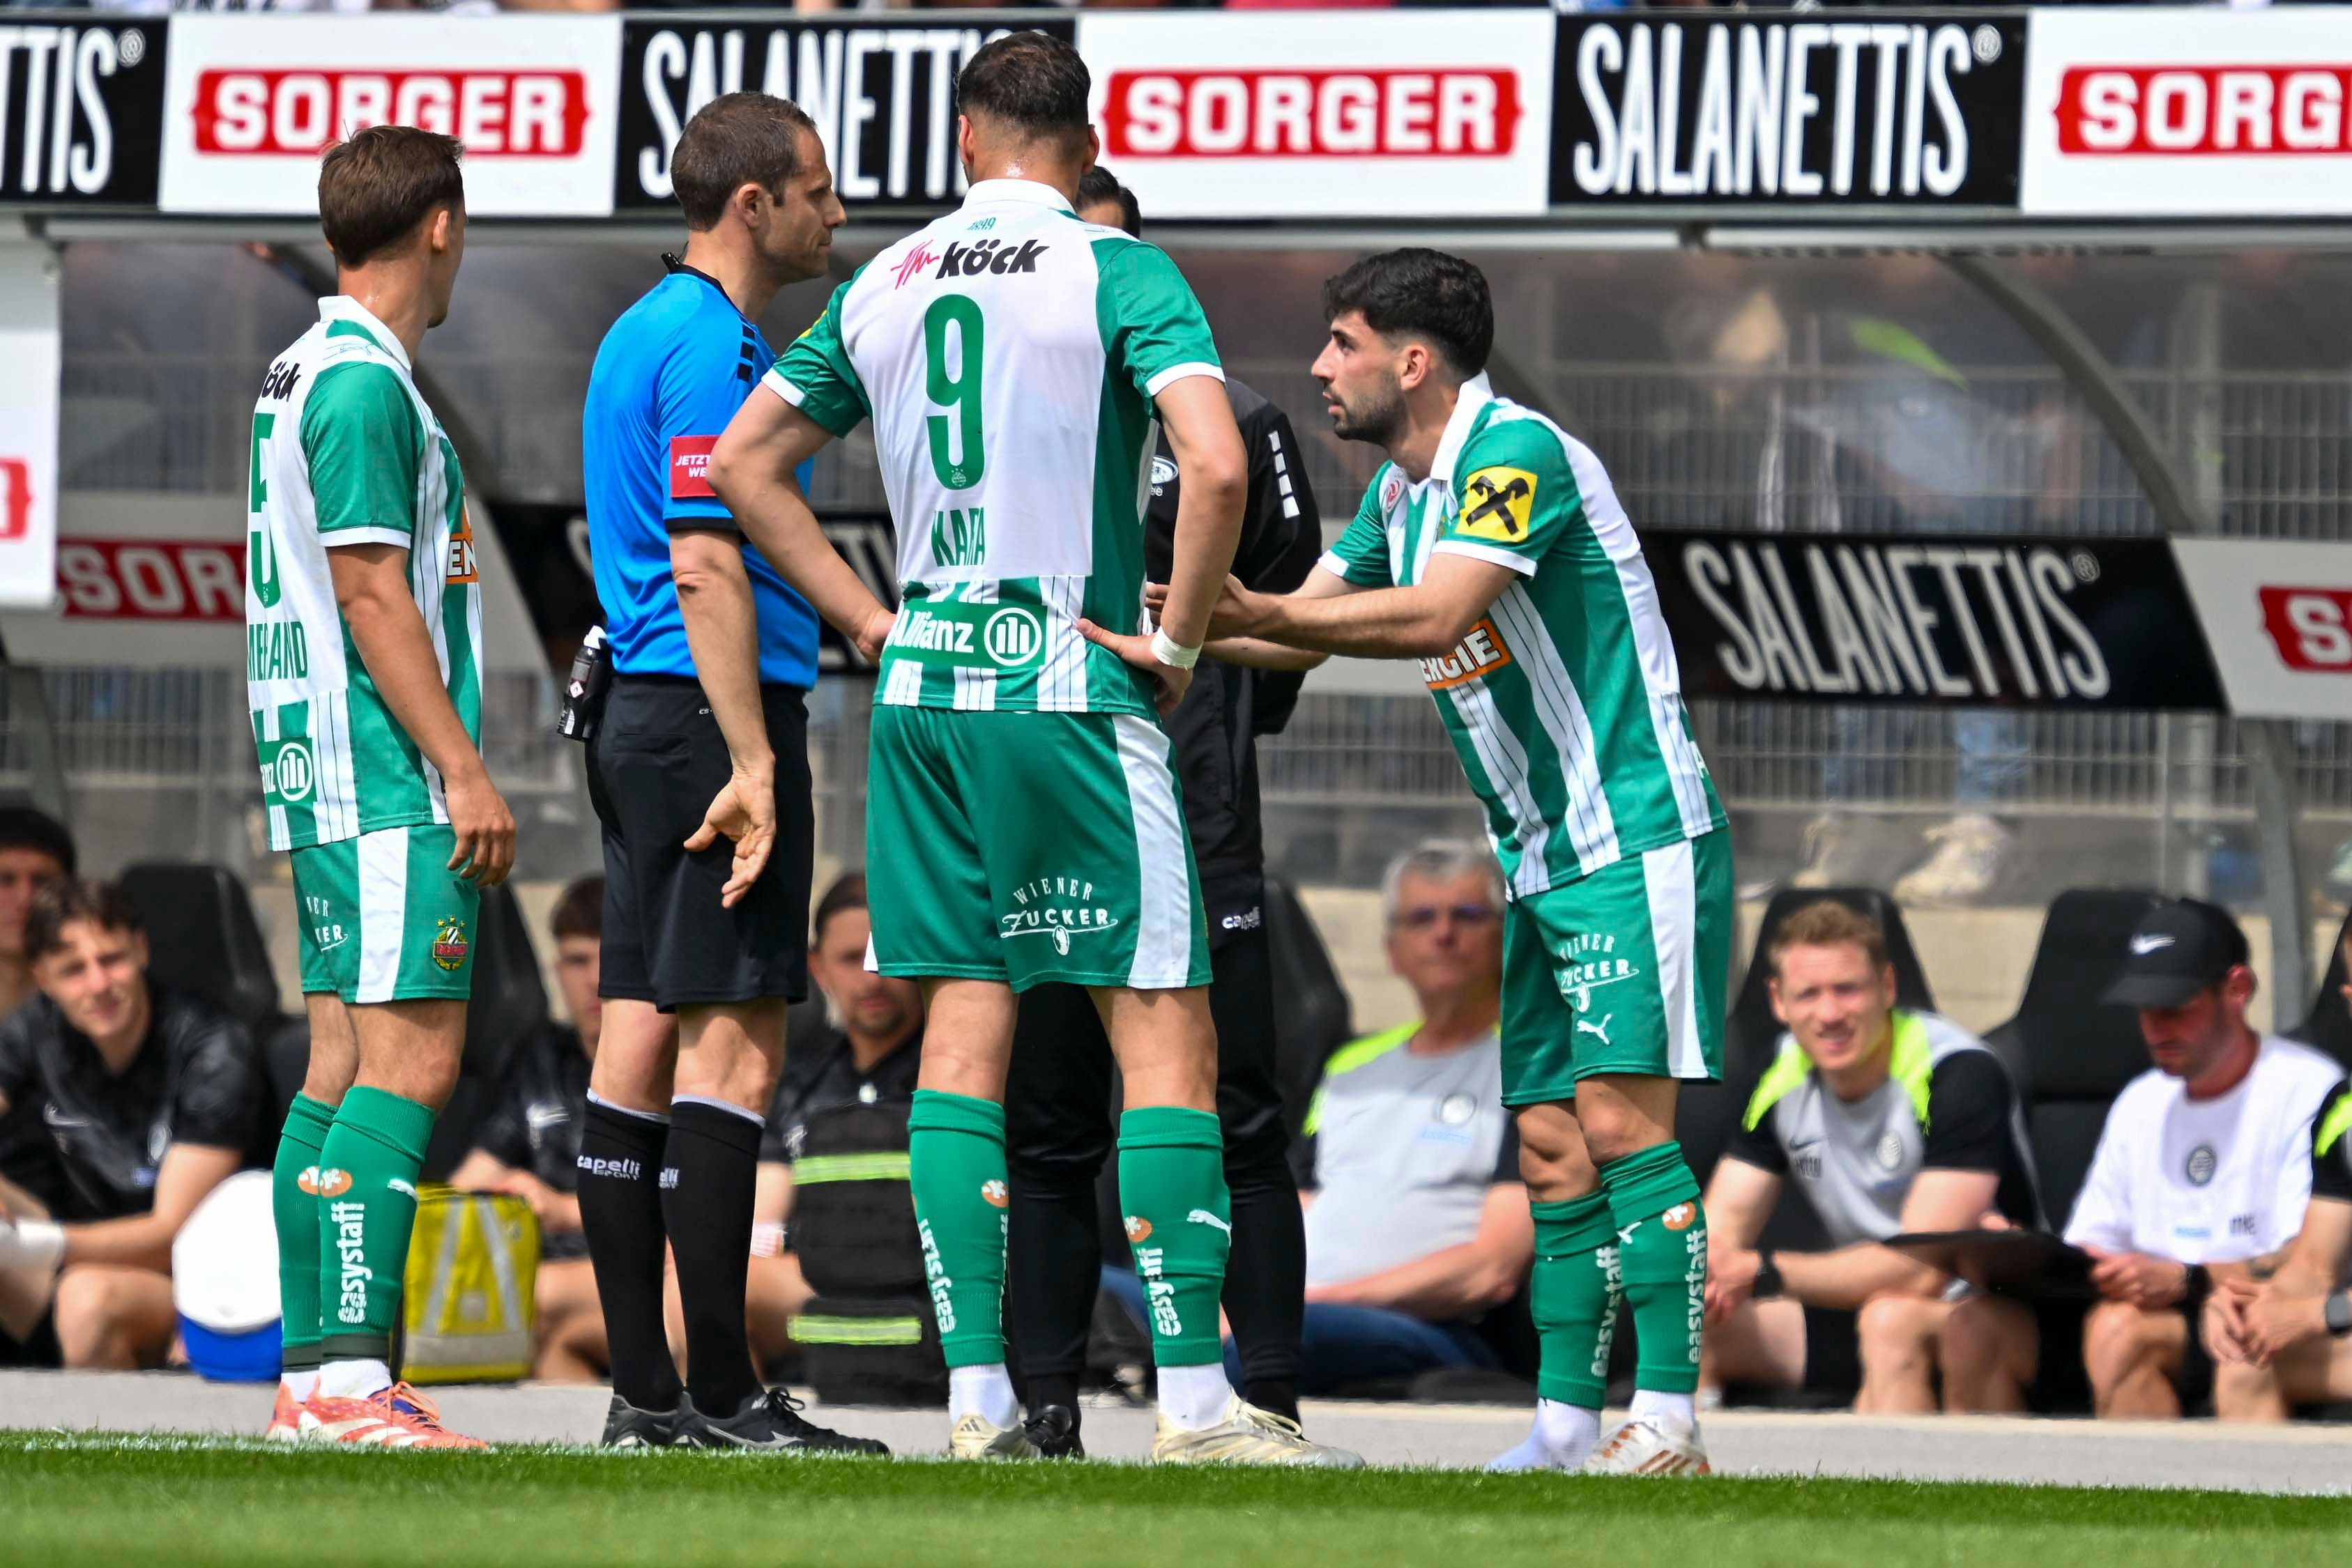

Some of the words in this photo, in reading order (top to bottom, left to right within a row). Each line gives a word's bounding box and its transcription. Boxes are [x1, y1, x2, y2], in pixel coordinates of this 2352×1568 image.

[212, 73, 568, 152] SORGER
[1124, 76, 1497, 153] SORGER
[2080, 72, 2352, 151] SORG
[935, 238, 1051, 279] köck
[924, 293, 985, 491] 9
[675, 454, 711, 467] JETZT
[688, 467, 707, 478] WE
[57, 544, 245, 615] SOR
[1001, 908, 1109, 934] ZUCKER
[1013, 877, 1093, 905] WIENER
[330, 1201, 373, 1323] easystaff
